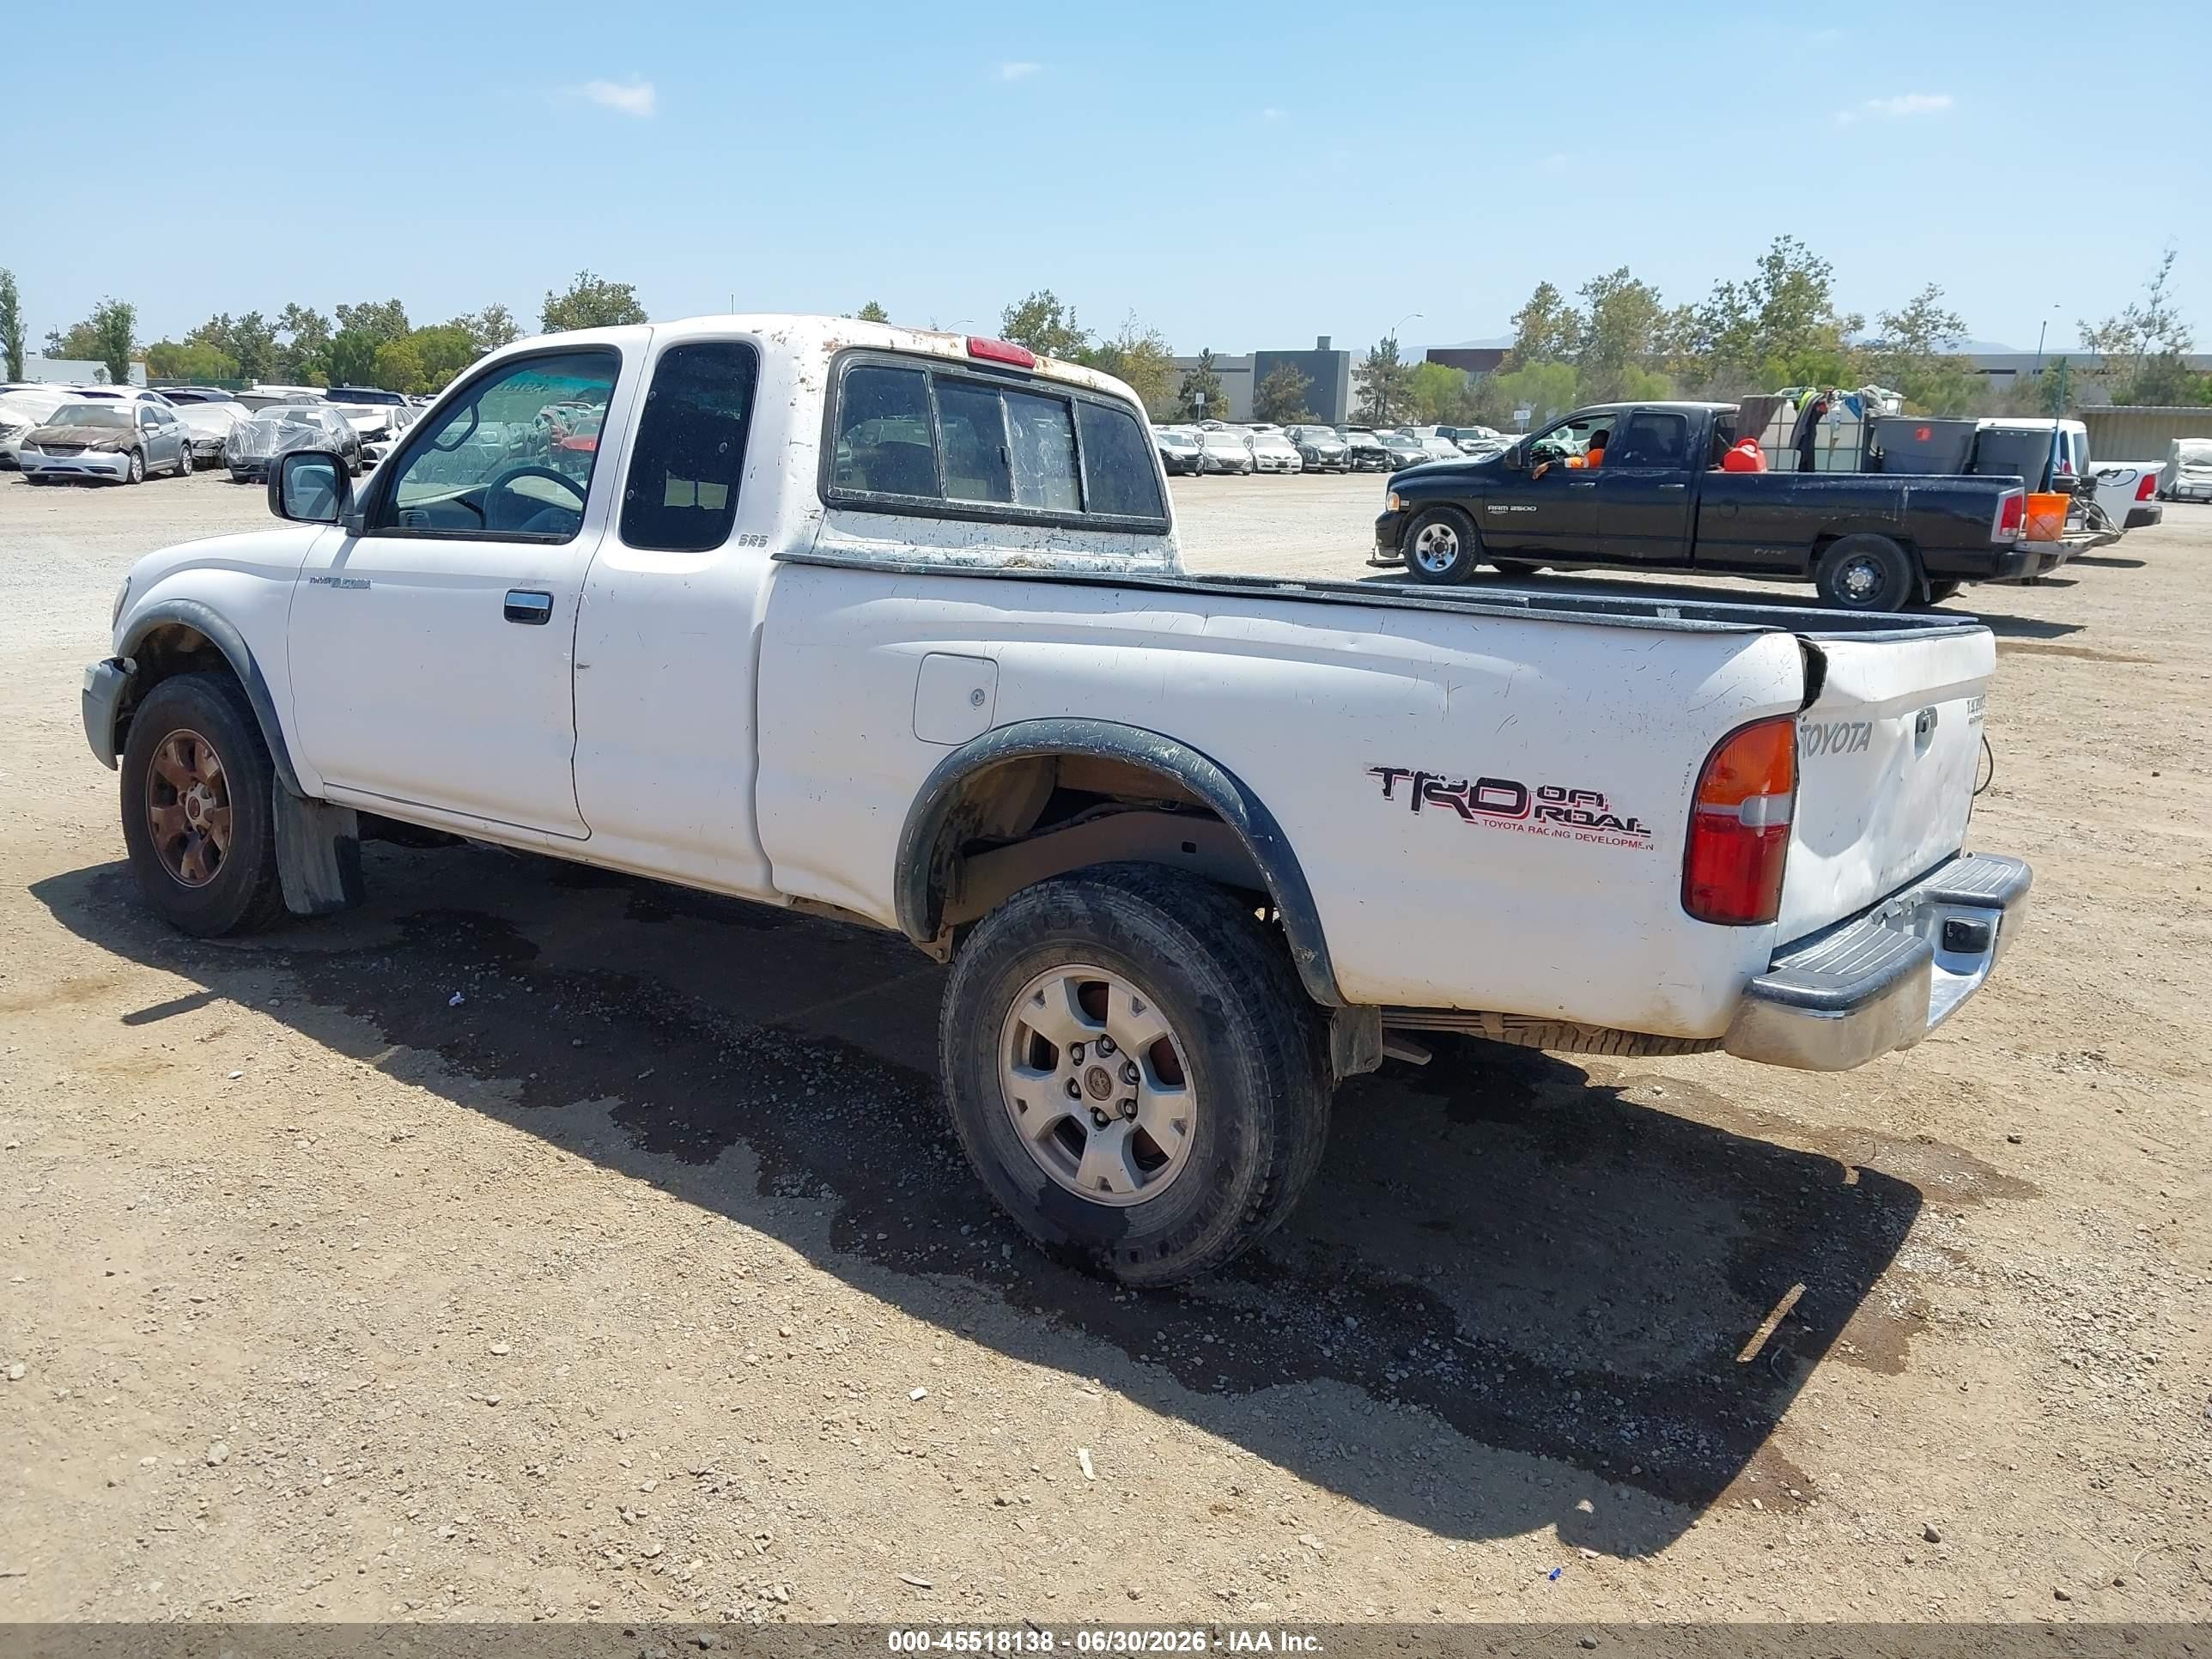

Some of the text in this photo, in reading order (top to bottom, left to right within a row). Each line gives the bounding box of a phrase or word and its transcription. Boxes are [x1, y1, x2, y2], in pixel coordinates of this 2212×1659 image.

[1800, 721, 1873, 759] TOYOTA
[1364, 766, 1532, 824] TRD
[1483, 818, 1524, 832] TOYOTA
[1528, 825, 1571, 839] RACING
